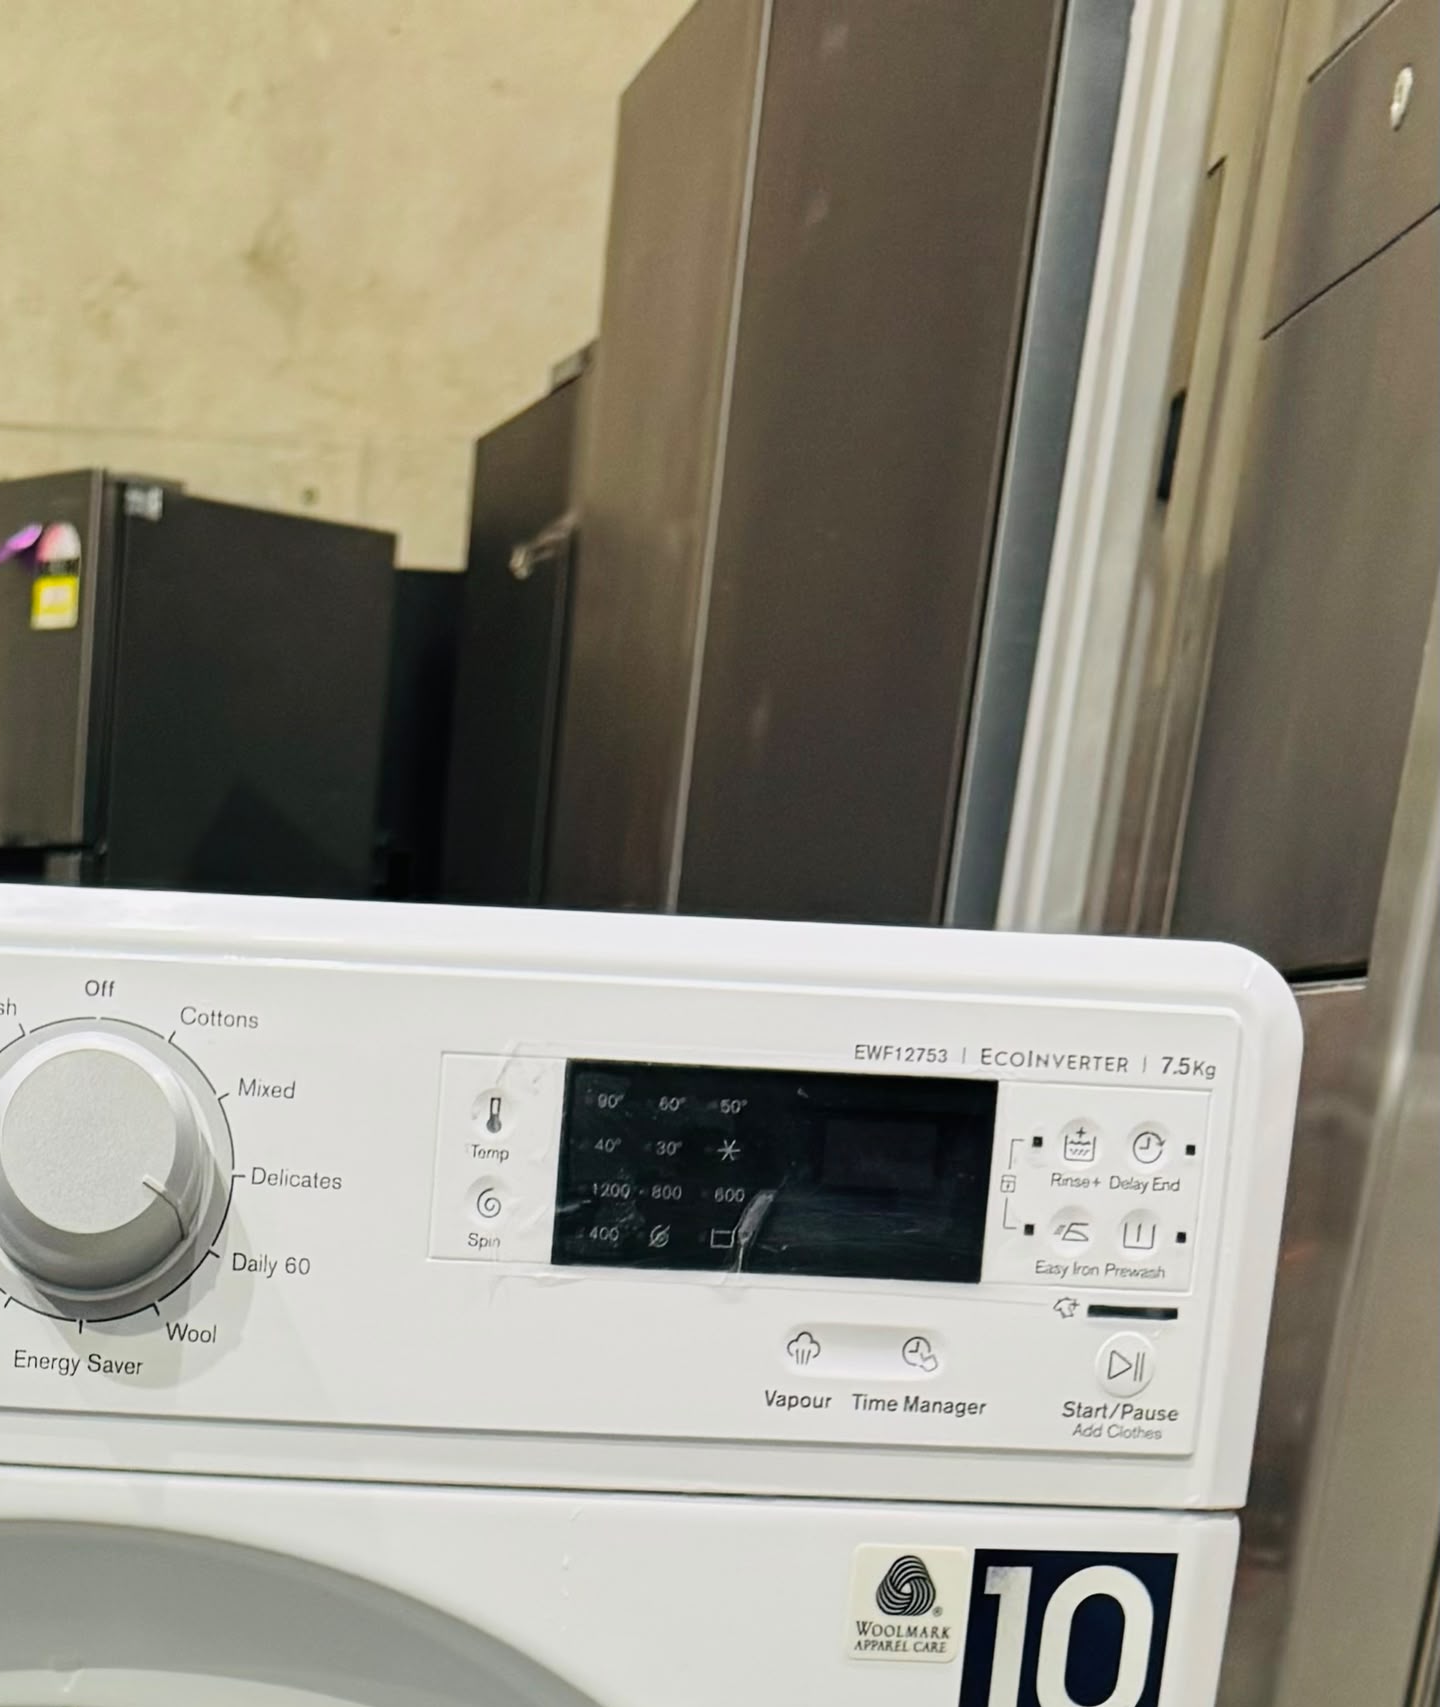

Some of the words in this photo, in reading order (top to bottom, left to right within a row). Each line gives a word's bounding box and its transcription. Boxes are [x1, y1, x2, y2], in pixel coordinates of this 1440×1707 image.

[84, 980, 115, 999] Off
[180, 1007, 259, 1030] Cottons
[855, 1044, 948, 1064] EWF12753
[1161, 1057, 1217, 1080] 7.5Kg
[238, 1079, 296, 1100] Mixed
[471, 1144, 509, 1163] Temp
[251, 1167, 342, 1191] Delicates
[1109, 1176, 1149, 1194] Delay
[1153, 1177, 1180, 1192] End
[593, 1183, 631, 1198] 1200
[651, 1185, 682, 1200] 800
[468, 1233, 501, 1249] Spin
[589, 1227, 619, 1242] 400
[232, 1252, 278, 1278] Daily
[284, 1256, 311, 1277] 60
[1035, 1260, 1069, 1279] Easy
[1073, 1262, 1099, 1277] Iron
[1105, 1262, 1165, 1280] Prewash
[166, 1321, 217, 1344] Wool
[14, 1350, 81, 1376] Energy
[87, 1355, 144, 1376] Saver
[765, 1390, 832, 1412] Vapour
[852, 1393, 898, 1413] Time
[903, 1395, 986, 1418] Manager
[1062, 1401, 1179, 1422] Start/Pause
[1072, 1423, 1103, 1438] Add
[1107, 1424, 1162, 1440] Clothes
[856, 1621, 951, 1640] WOOLMARK
[854, 1639, 910, 1653] APPAREL
[913, 1641, 948, 1654] CARE
